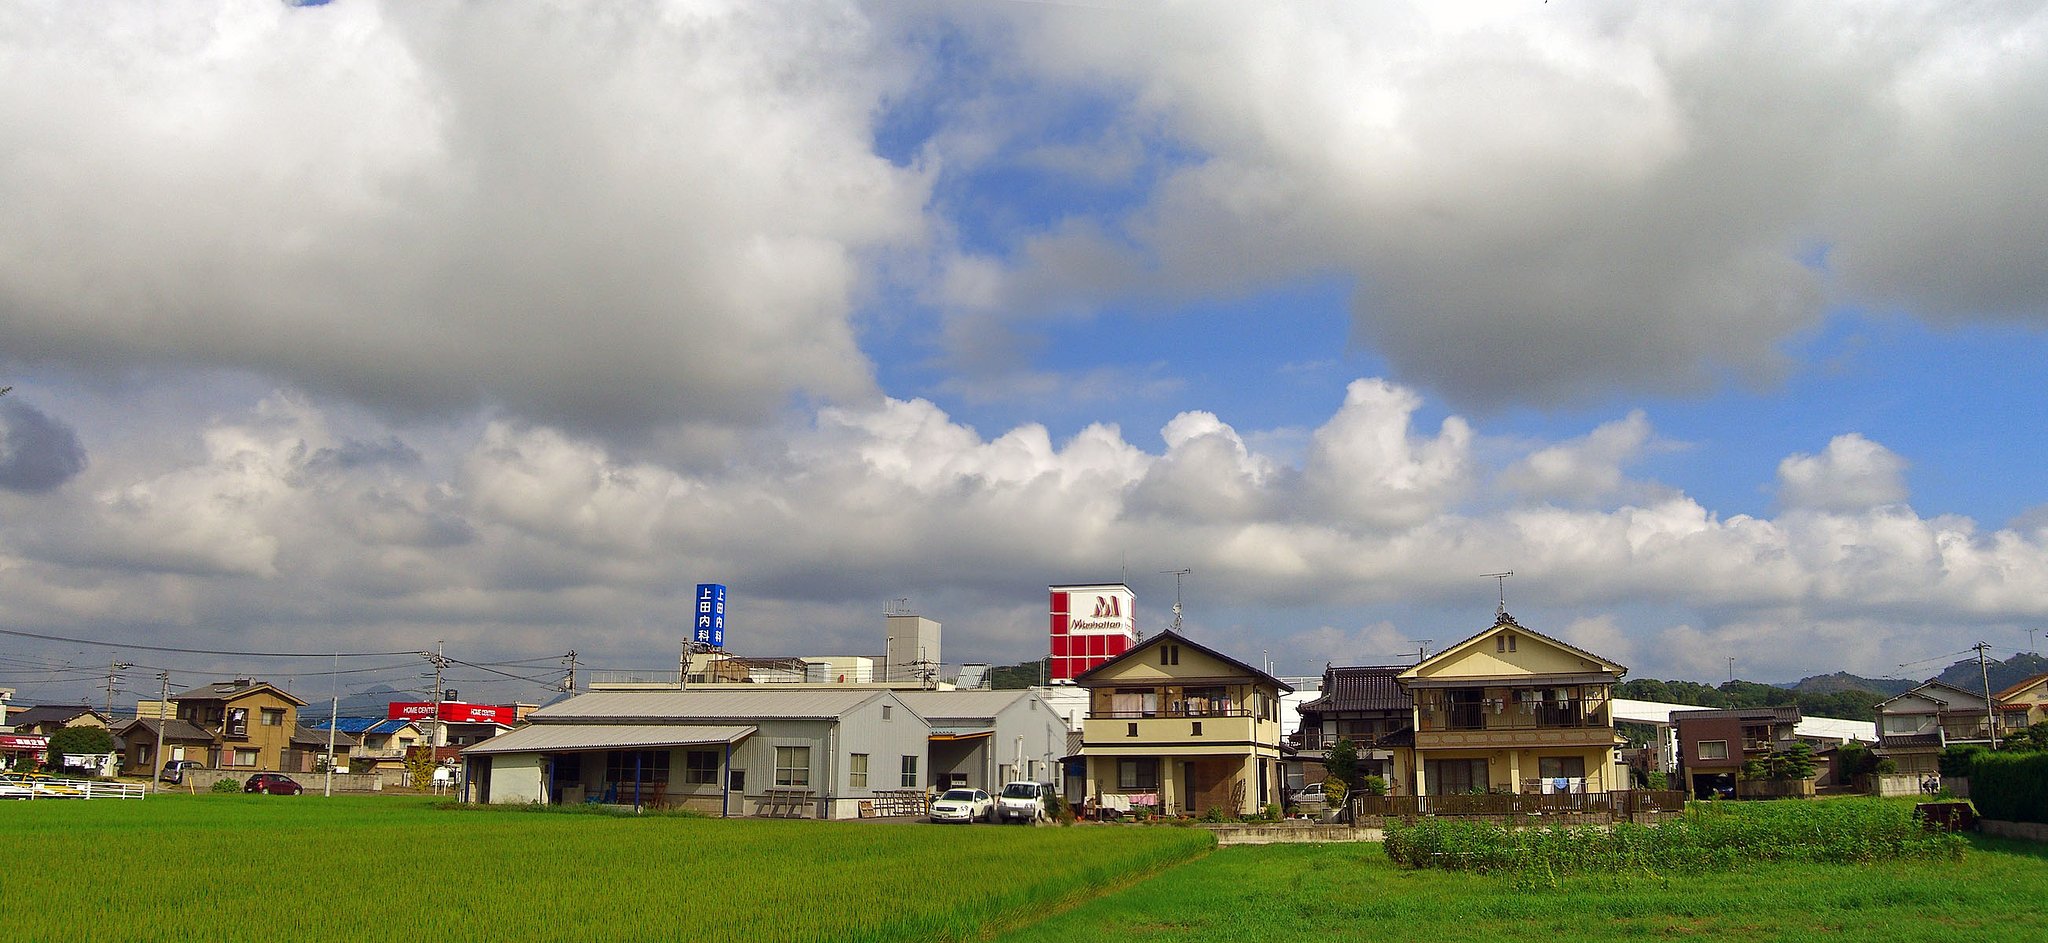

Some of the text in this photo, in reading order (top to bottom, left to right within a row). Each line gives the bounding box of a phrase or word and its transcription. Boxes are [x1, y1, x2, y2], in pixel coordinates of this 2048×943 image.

[698, 587, 711, 642] 上田内科
[715, 588, 724, 643] 上田内科
[1070, 619, 1121, 630] Manhattan
[403, 706, 436, 714] HOME CENTE
[470, 708, 496, 717] HOME CENTER
